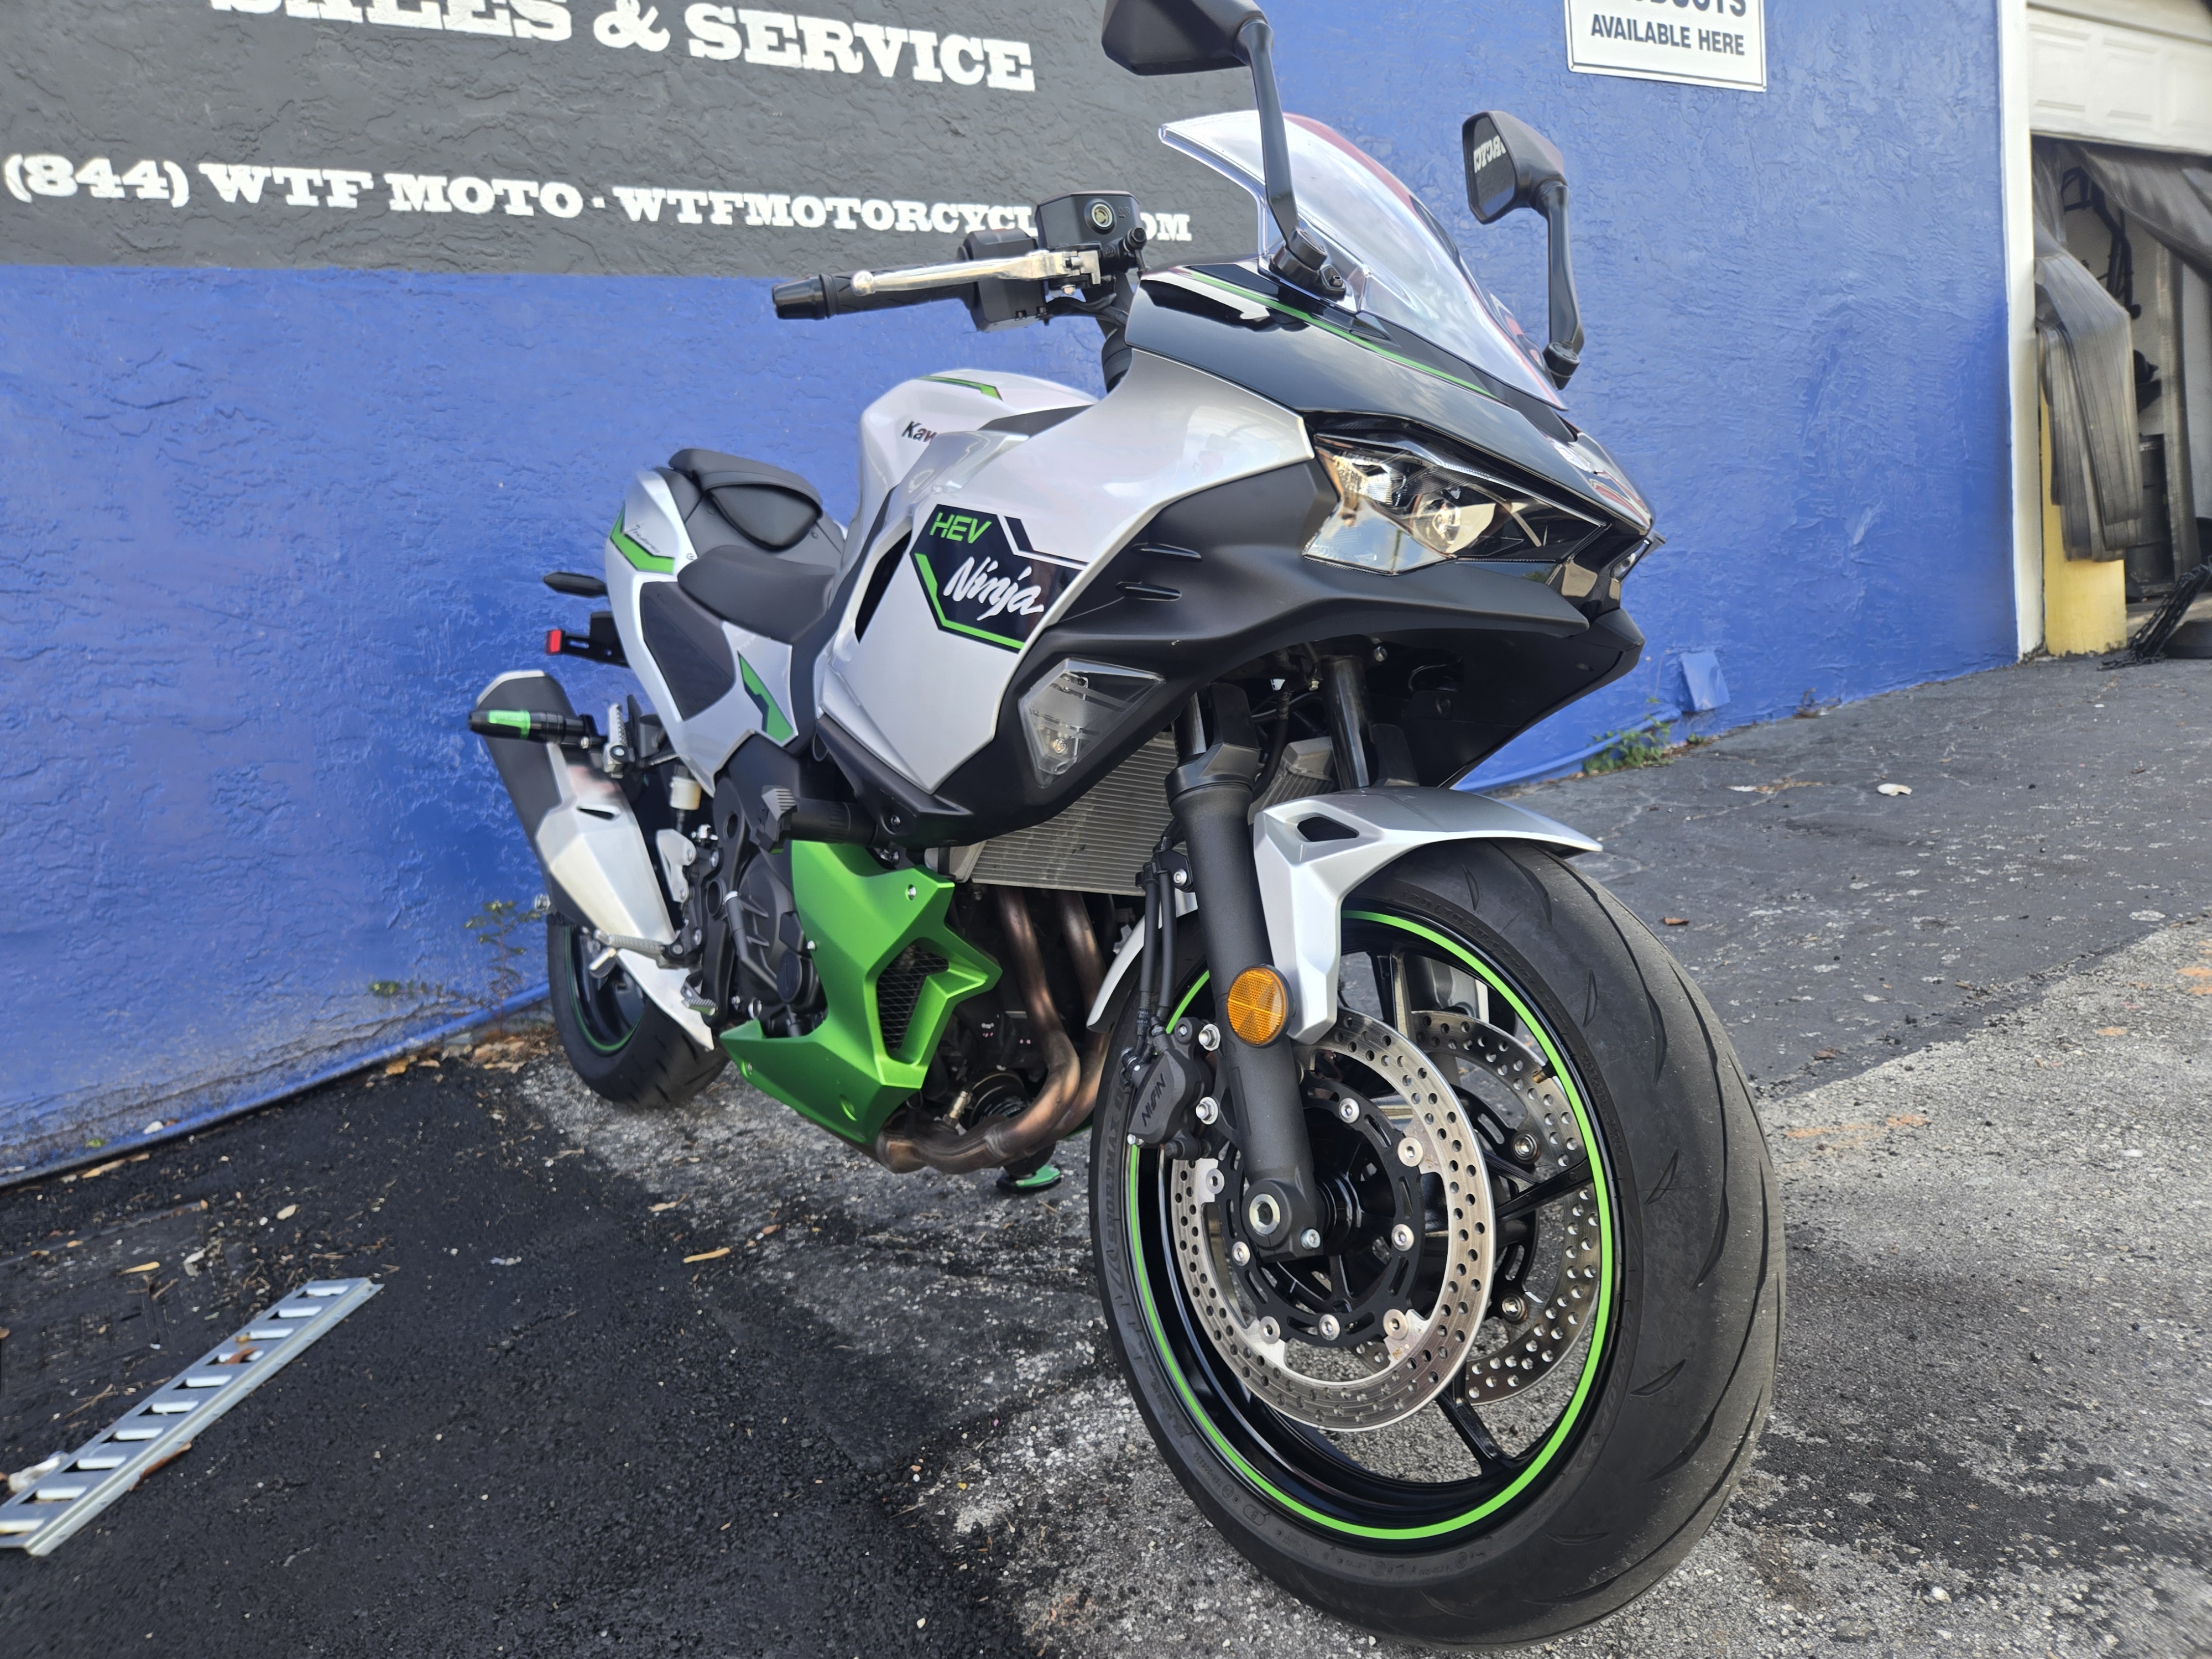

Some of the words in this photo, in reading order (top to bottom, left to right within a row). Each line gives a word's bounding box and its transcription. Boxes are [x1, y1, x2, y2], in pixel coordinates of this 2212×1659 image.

[593, 0, 670, 51] &
[685, 3, 1035, 92] SERVICE
[1591, 14, 1691, 49] AVAILABLE
[1698, 29, 1744, 55] HERE
[4, 154, 189, 207] (844)
[199, 163, 374, 208] WTF
[384, 173, 583, 218] MOTO
[930, 512, 992, 544] HEV
[943, 556, 1044, 621] Ninja
[1601, 1307, 1634, 1428] DUNLOP
